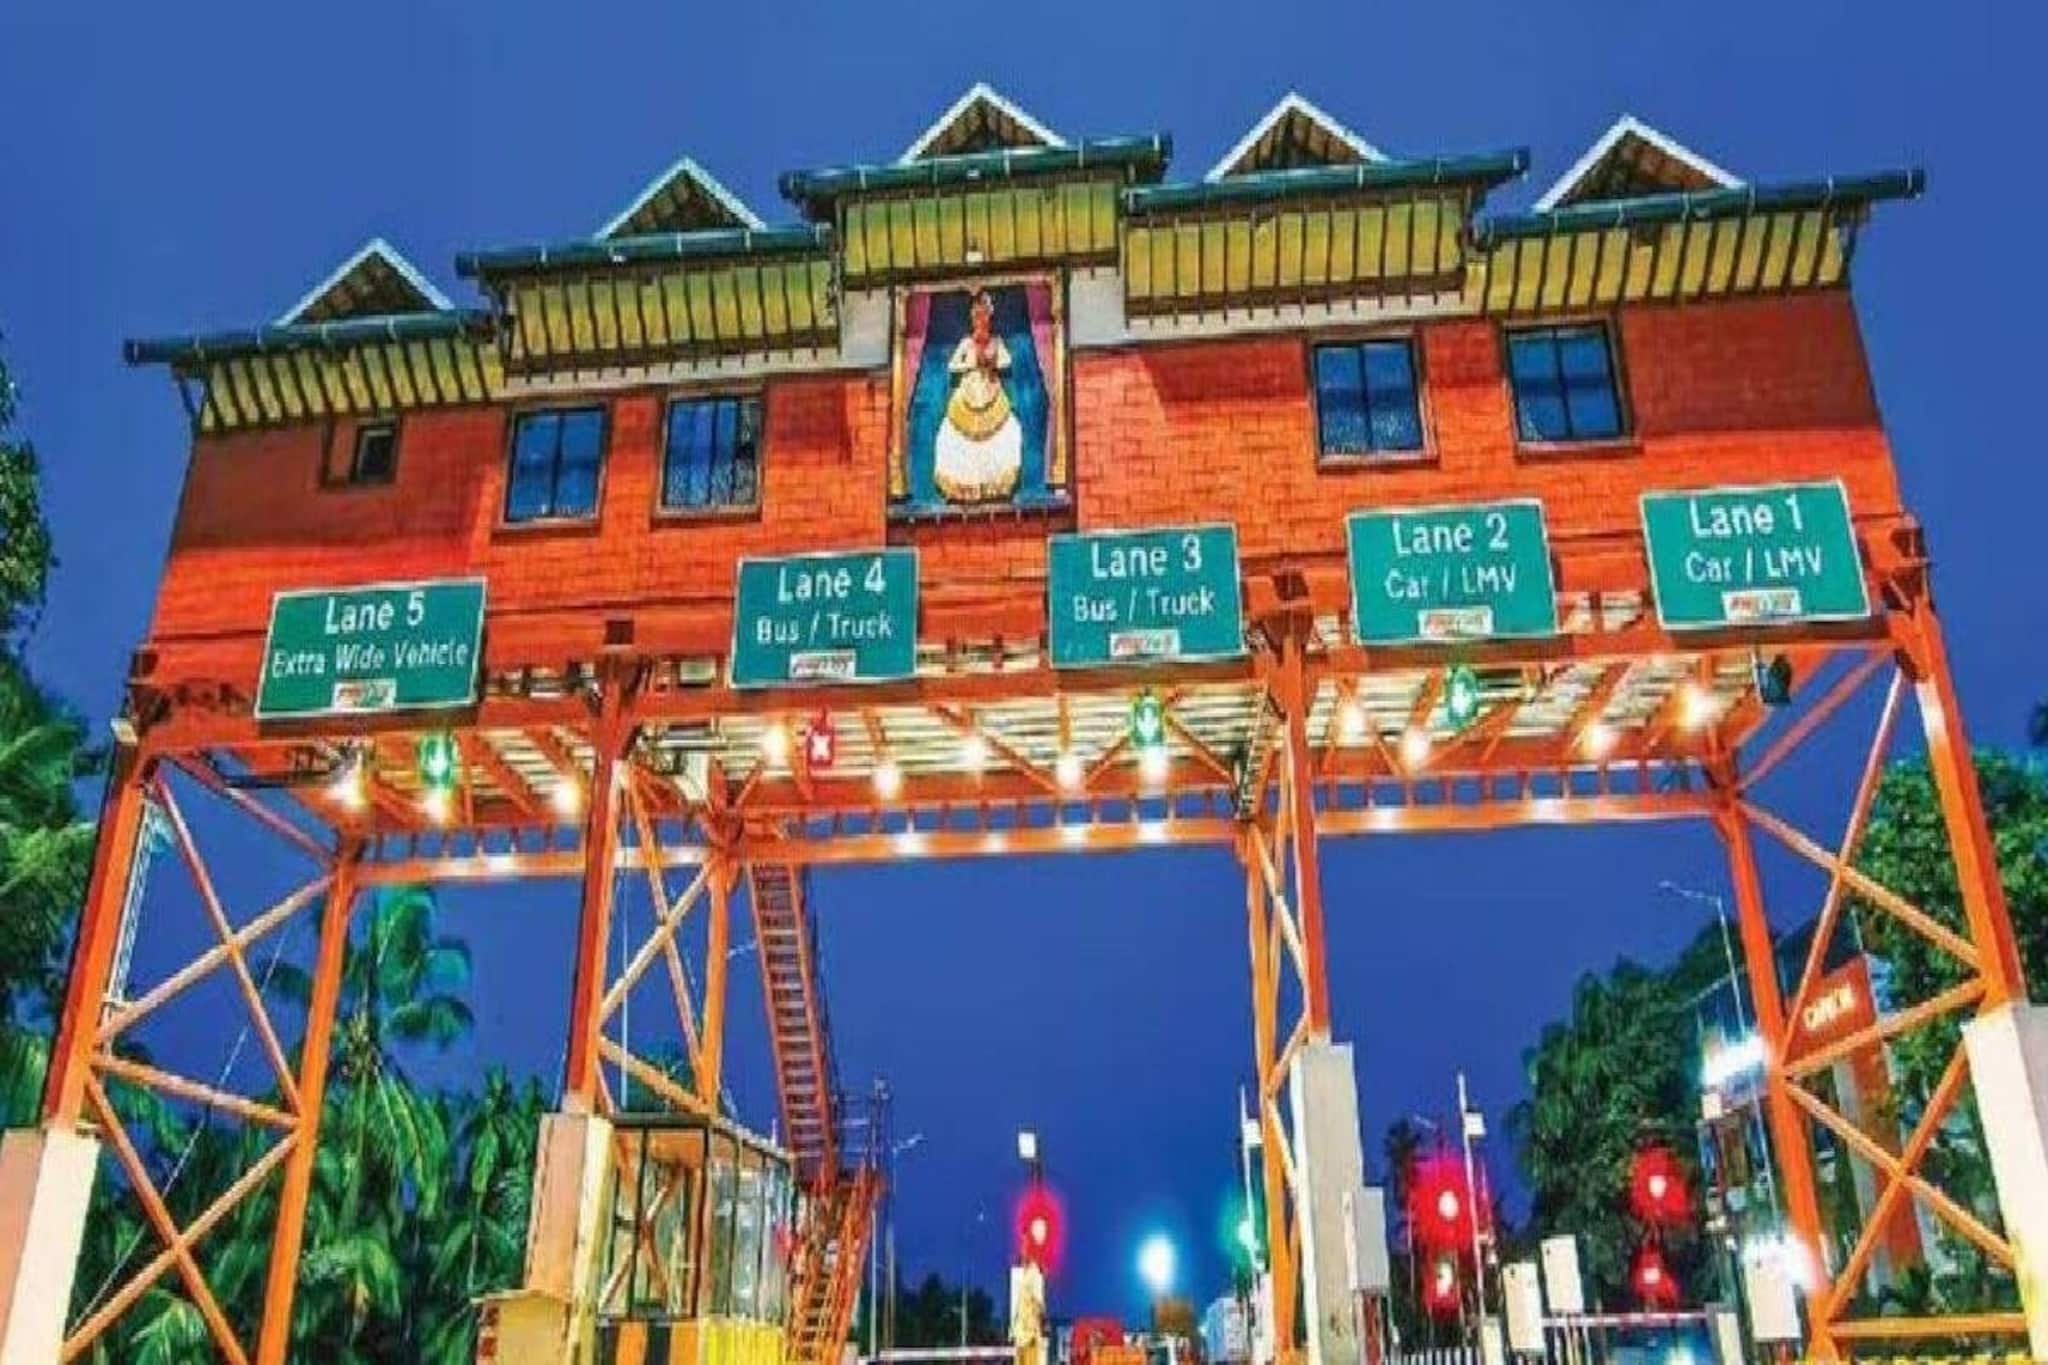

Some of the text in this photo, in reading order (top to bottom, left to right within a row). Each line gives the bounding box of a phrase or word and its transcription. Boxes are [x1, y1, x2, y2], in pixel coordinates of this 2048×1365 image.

[1391, 512, 1509, 555] Lane 2
[1689, 494, 1803, 538] Lane 1
[1091, 533, 1202, 578] Lane 3
[1684, 551, 1732, 582] Car
[1764, 546, 1821, 578] LMV
[777, 557, 886, 603] Lane 4
[1384, 567, 1429, 599] Car
[1461, 563, 1516, 594] LMV
[324, 591, 425, 634] Lane 5
[1073, 585, 1215, 623] Bus / Truck
[756, 610, 892, 646] Bus / Truck
[271, 638, 469, 678] Extra Wide Vehicle
